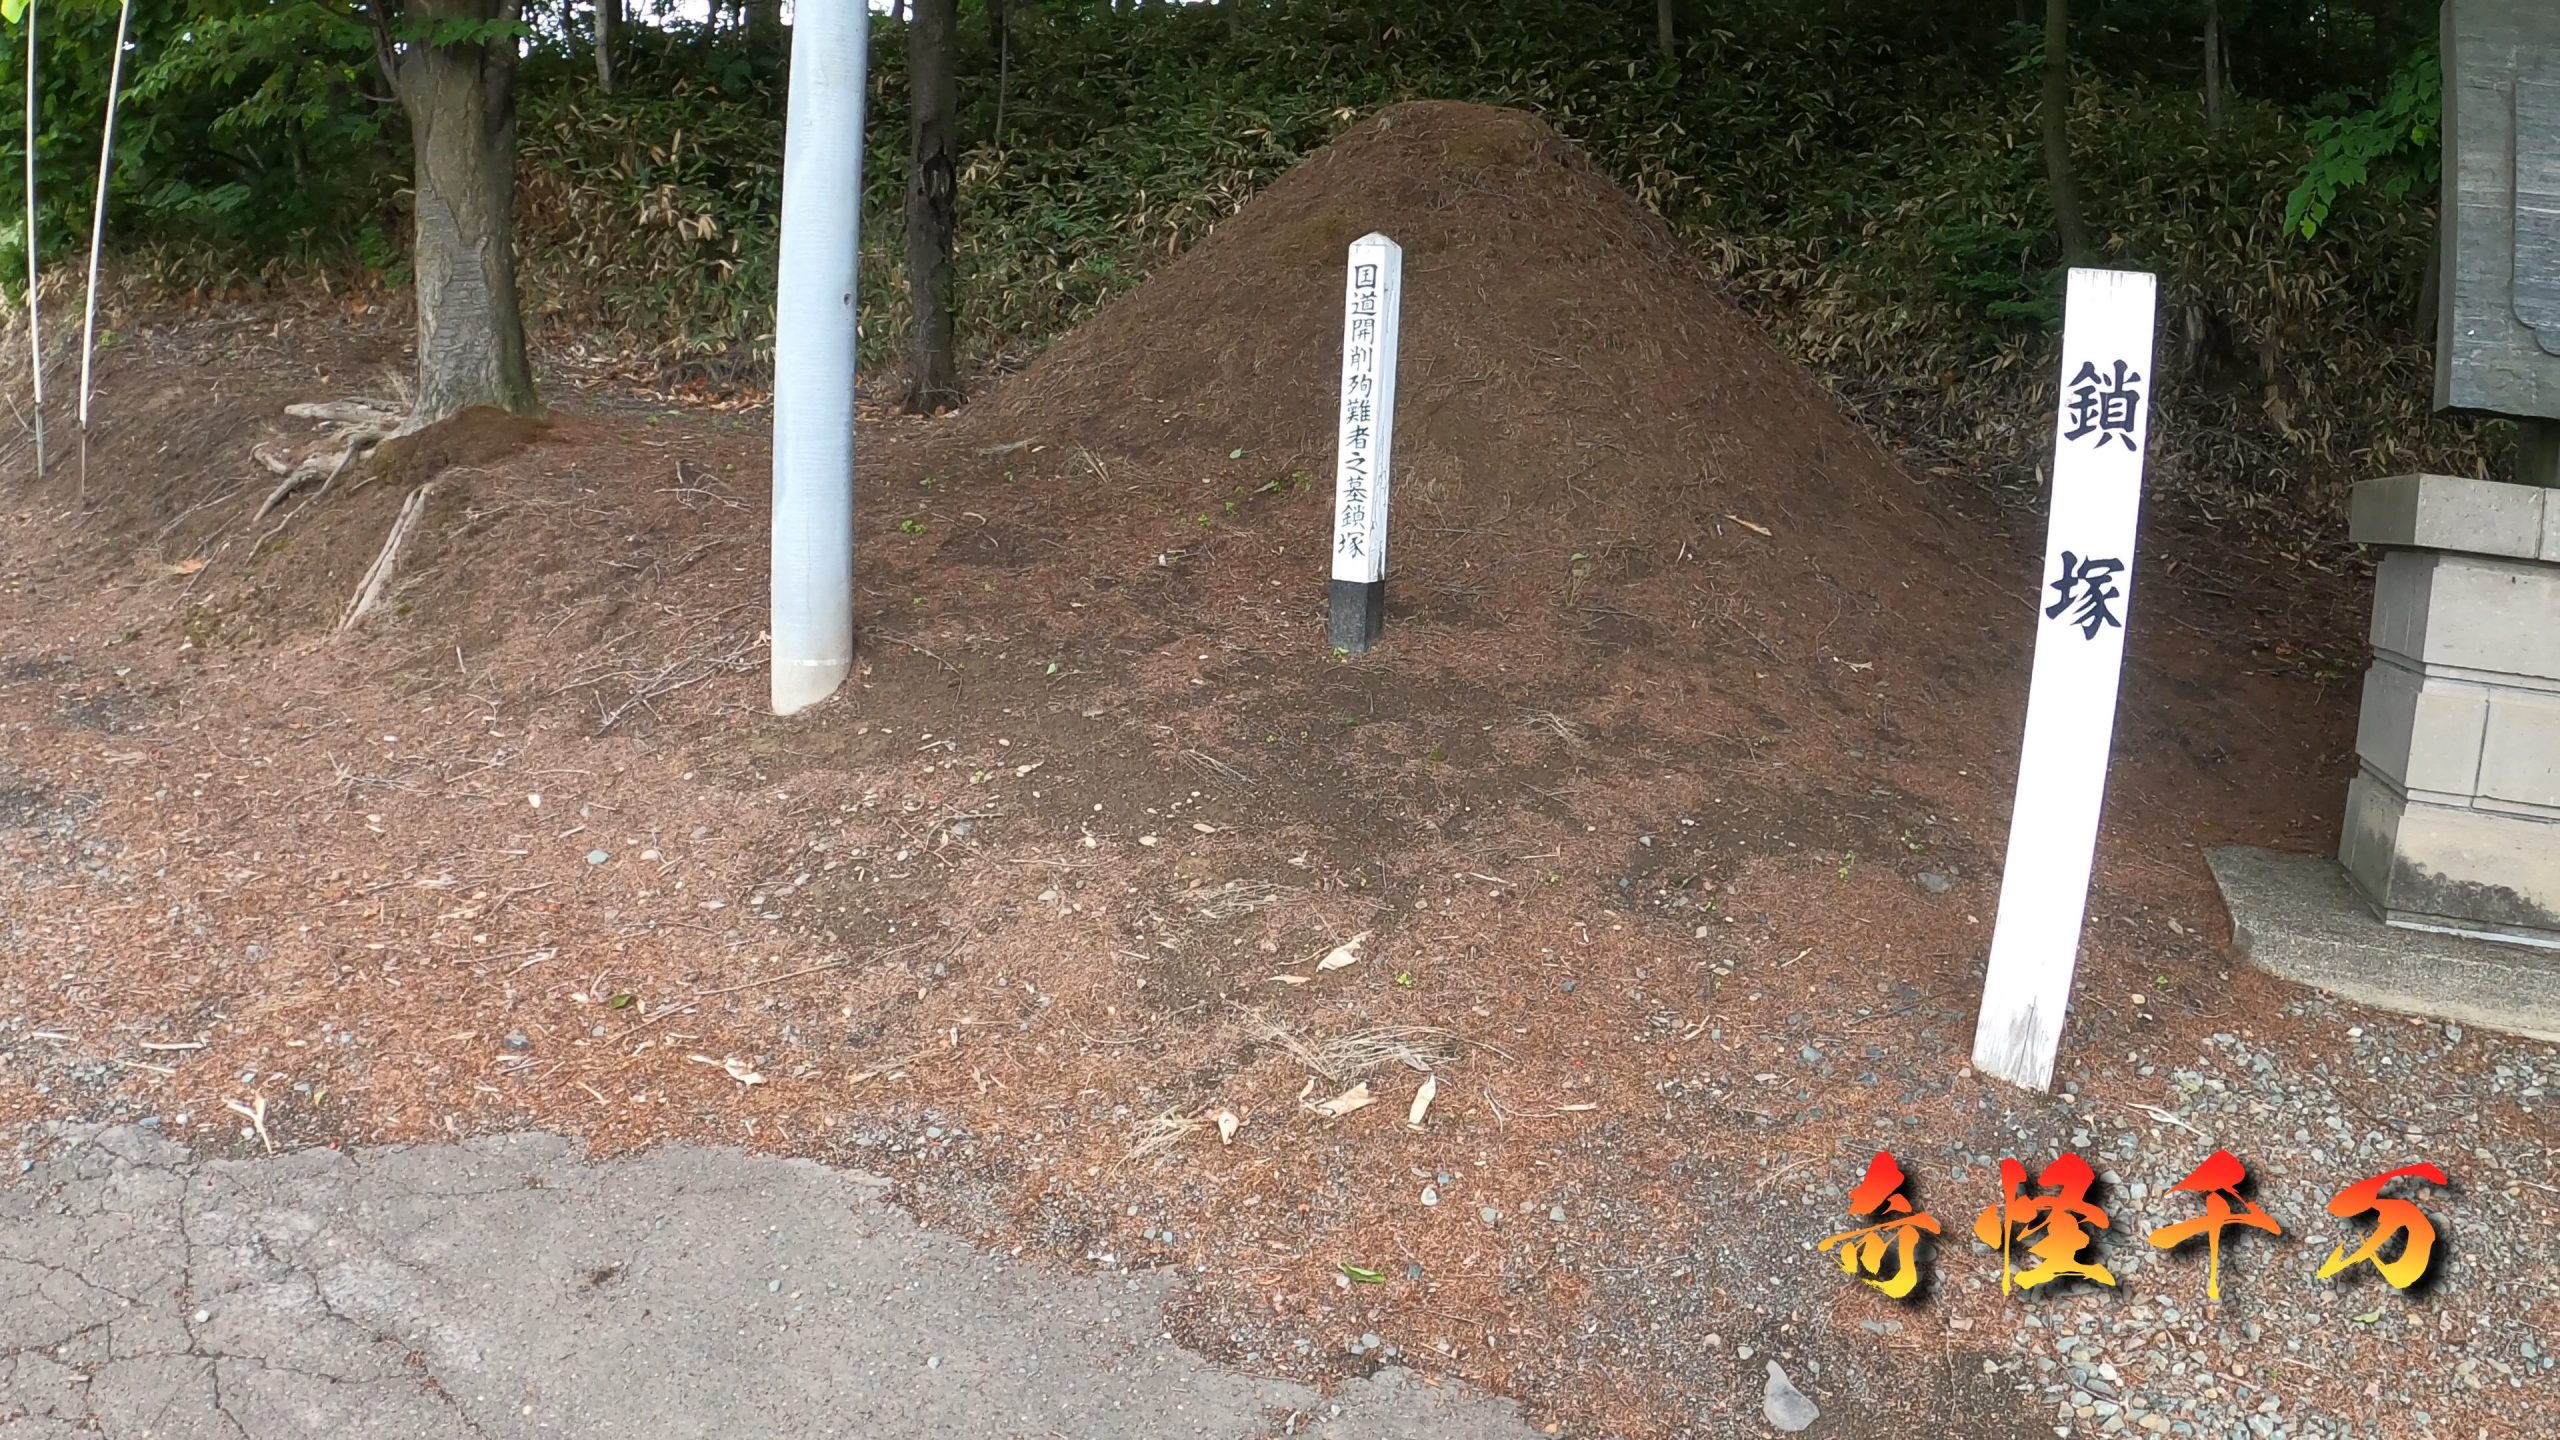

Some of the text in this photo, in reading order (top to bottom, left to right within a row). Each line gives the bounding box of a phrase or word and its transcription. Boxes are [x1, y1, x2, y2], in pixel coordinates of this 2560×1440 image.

[1338, 264, 1378, 558] 国道開削殉難者之墓鎖塚
[2045, 359, 2141, 640] 鎖塚
